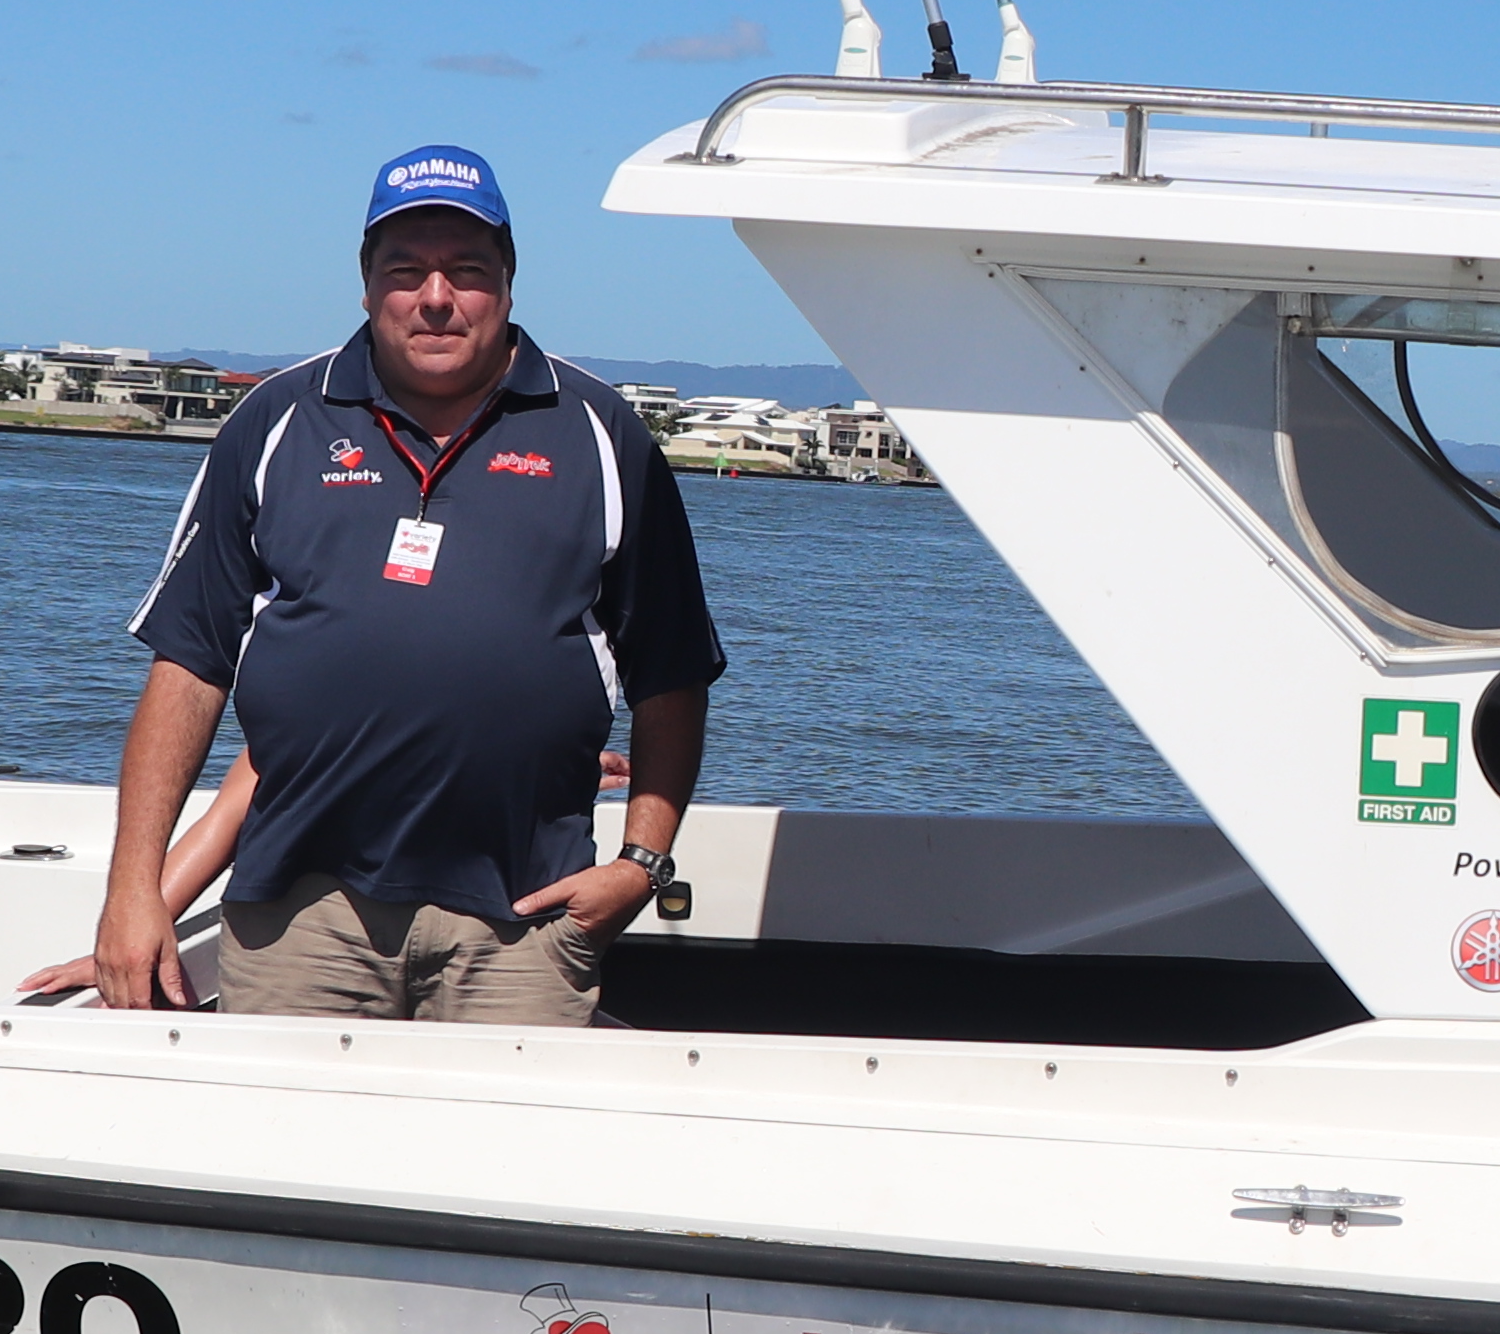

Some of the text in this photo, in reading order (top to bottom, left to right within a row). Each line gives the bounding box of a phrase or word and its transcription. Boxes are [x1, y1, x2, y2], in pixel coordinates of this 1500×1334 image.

[408, 158, 480, 184] YAMAHA
[321, 469, 380, 483] variety
[1363, 803, 1452, 822] FIRST AID
